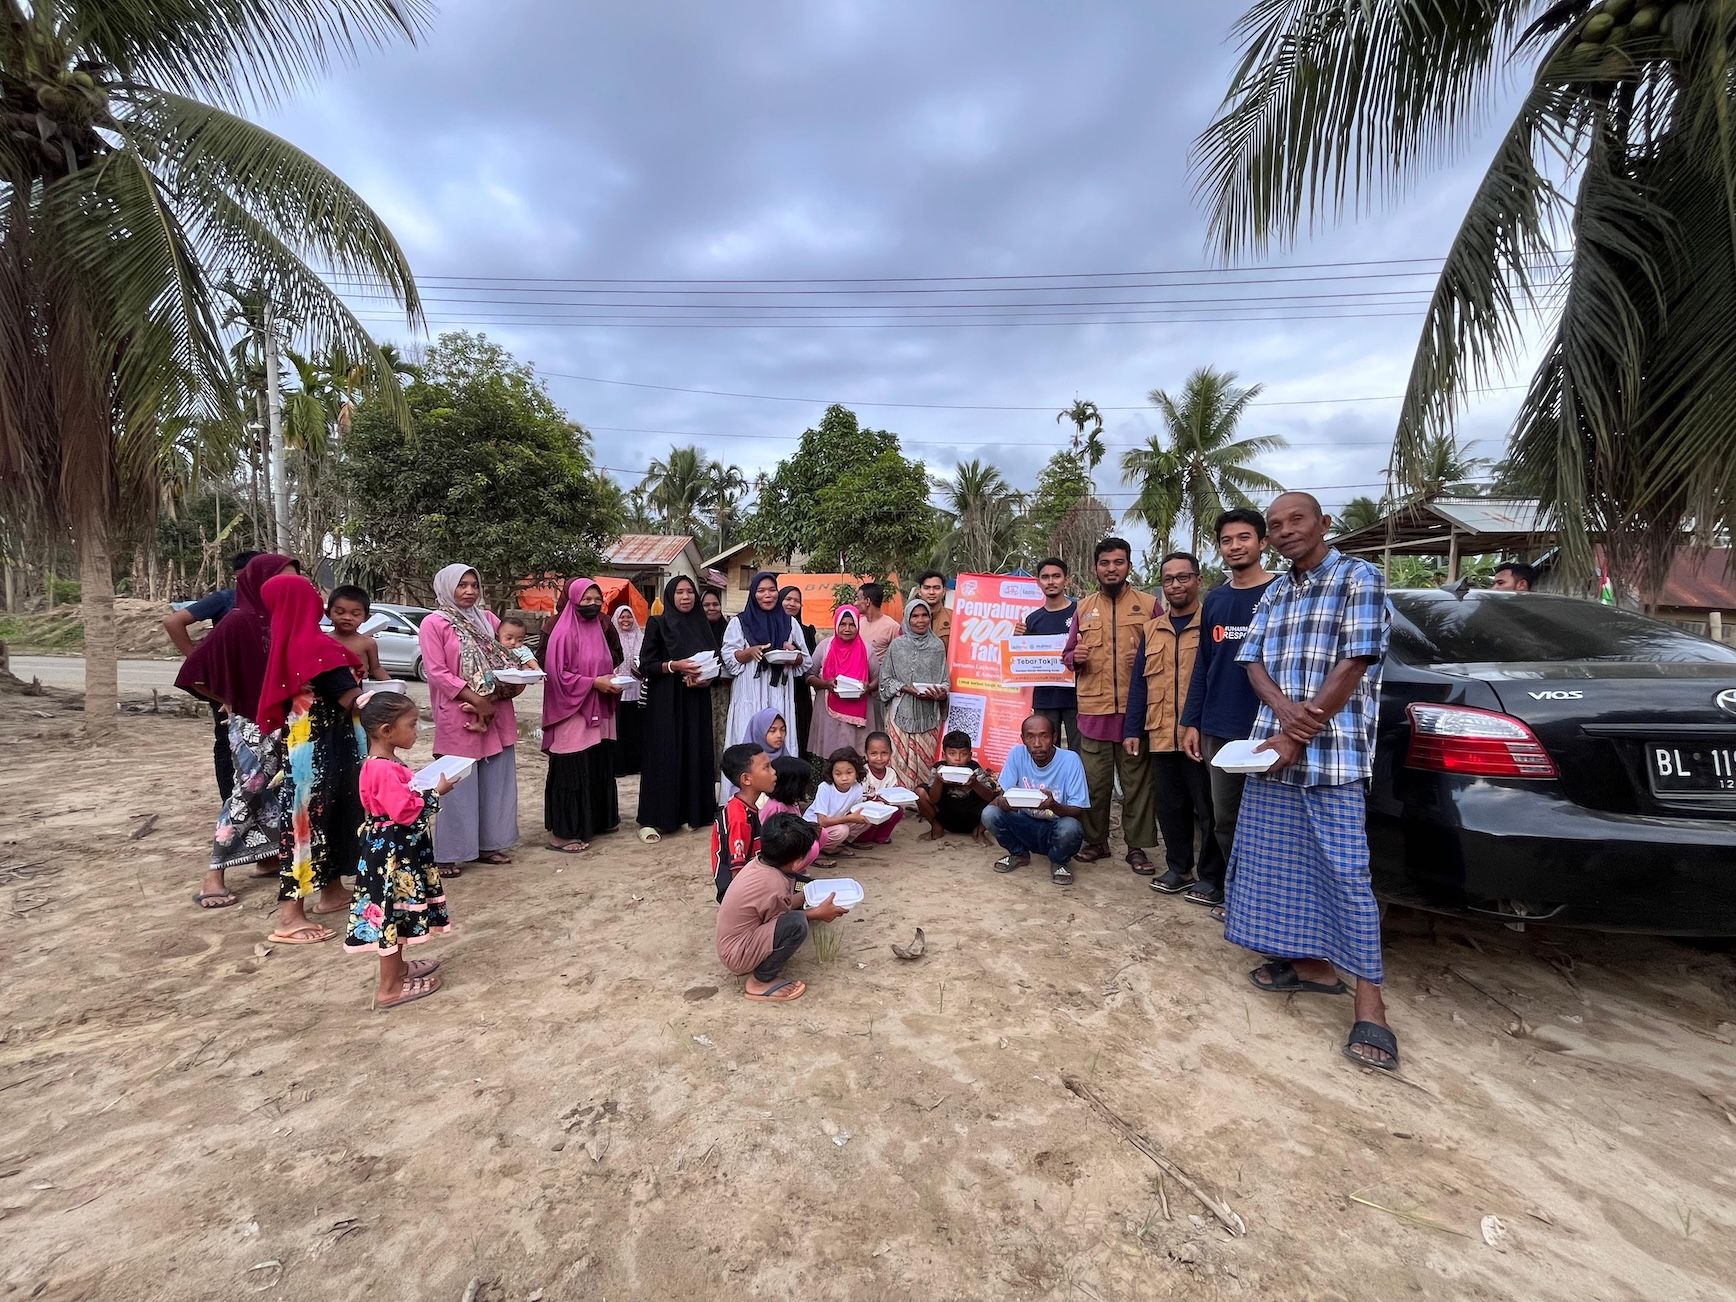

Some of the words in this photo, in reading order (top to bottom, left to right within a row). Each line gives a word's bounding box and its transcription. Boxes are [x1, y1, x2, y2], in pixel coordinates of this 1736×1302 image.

[1039, 658, 1058, 666] Takjil
[1528, 690, 1583, 700] VIOS
[1656, 749, 1691, 776] BL
[1711, 749, 1736, 776] 11
[1720, 780, 1735, 789] 12
